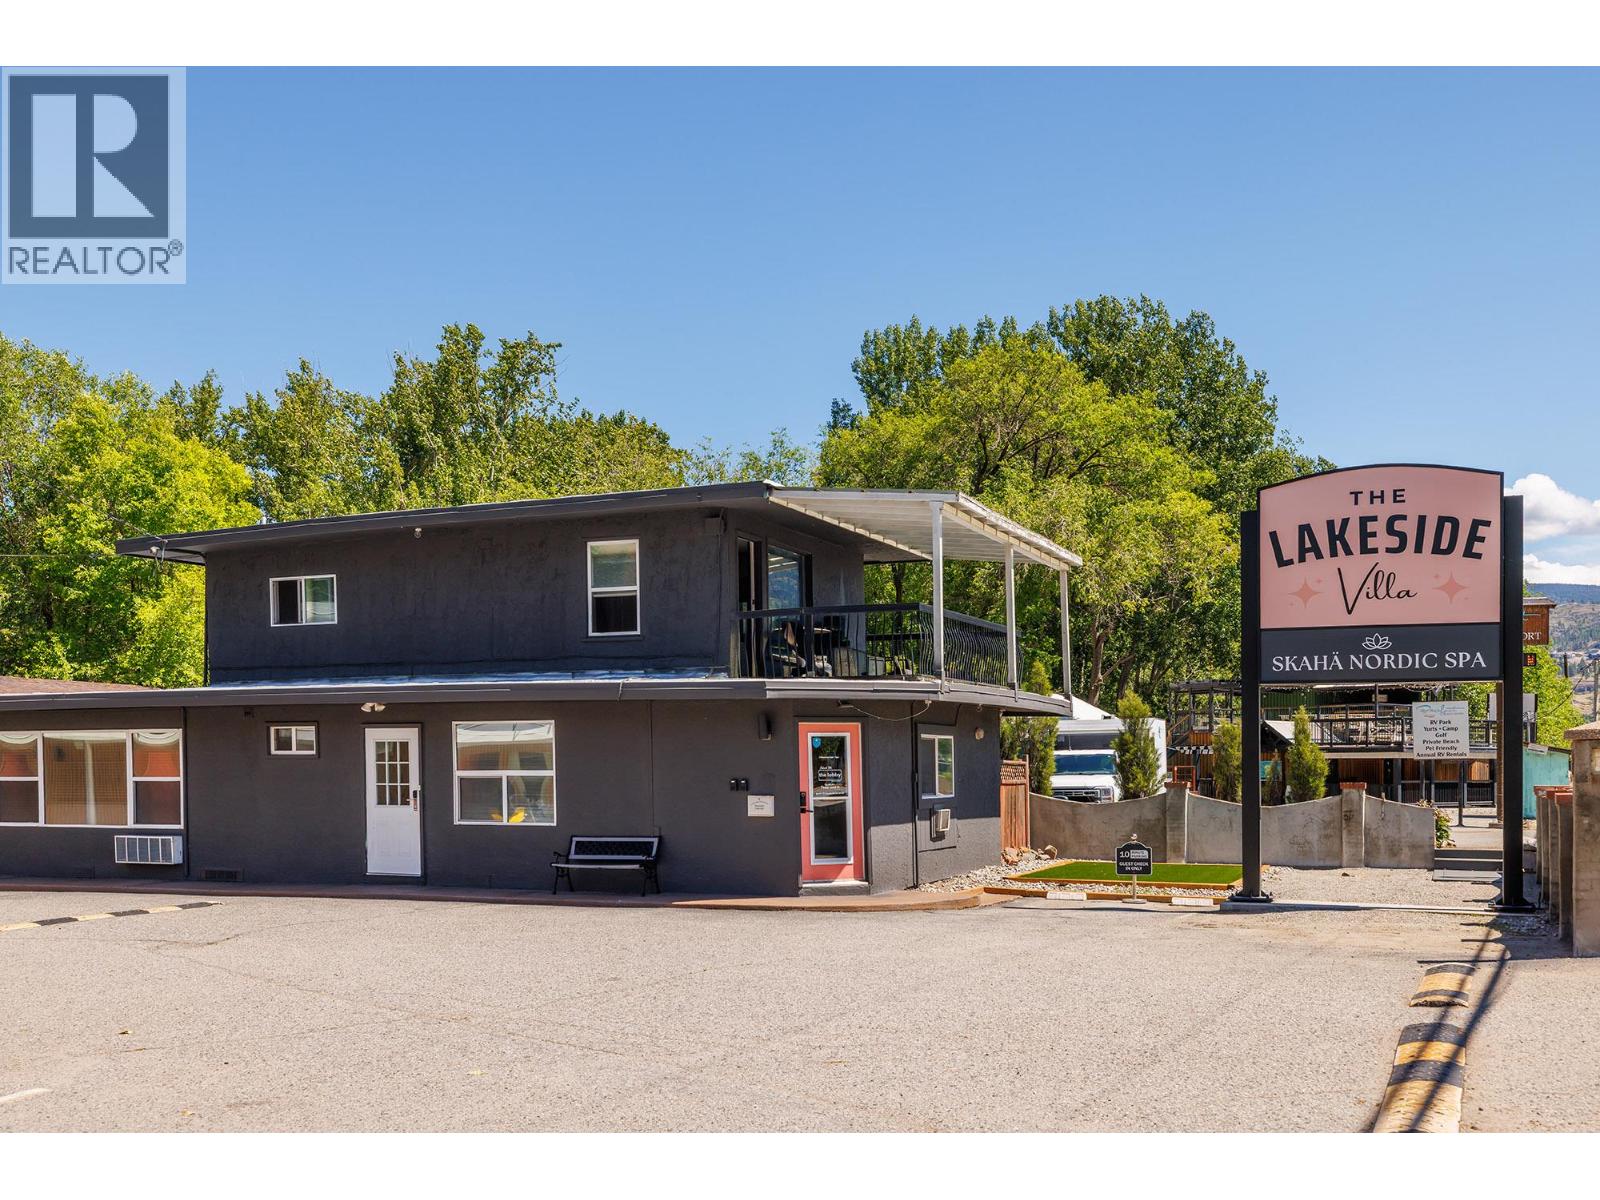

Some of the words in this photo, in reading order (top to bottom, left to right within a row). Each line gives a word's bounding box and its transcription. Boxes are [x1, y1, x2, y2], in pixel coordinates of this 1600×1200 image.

[1349, 488, 1406, 505] THE
[1268, 514, 1492, 568] LAKESIDE
[1337, 562, 1418, 615] Villa
[1272, 651, 1343, 672] SKAHÄ
[1350, 652, 1438, 670] NORDIC
[1444, 651, 1487, 669] SPA
